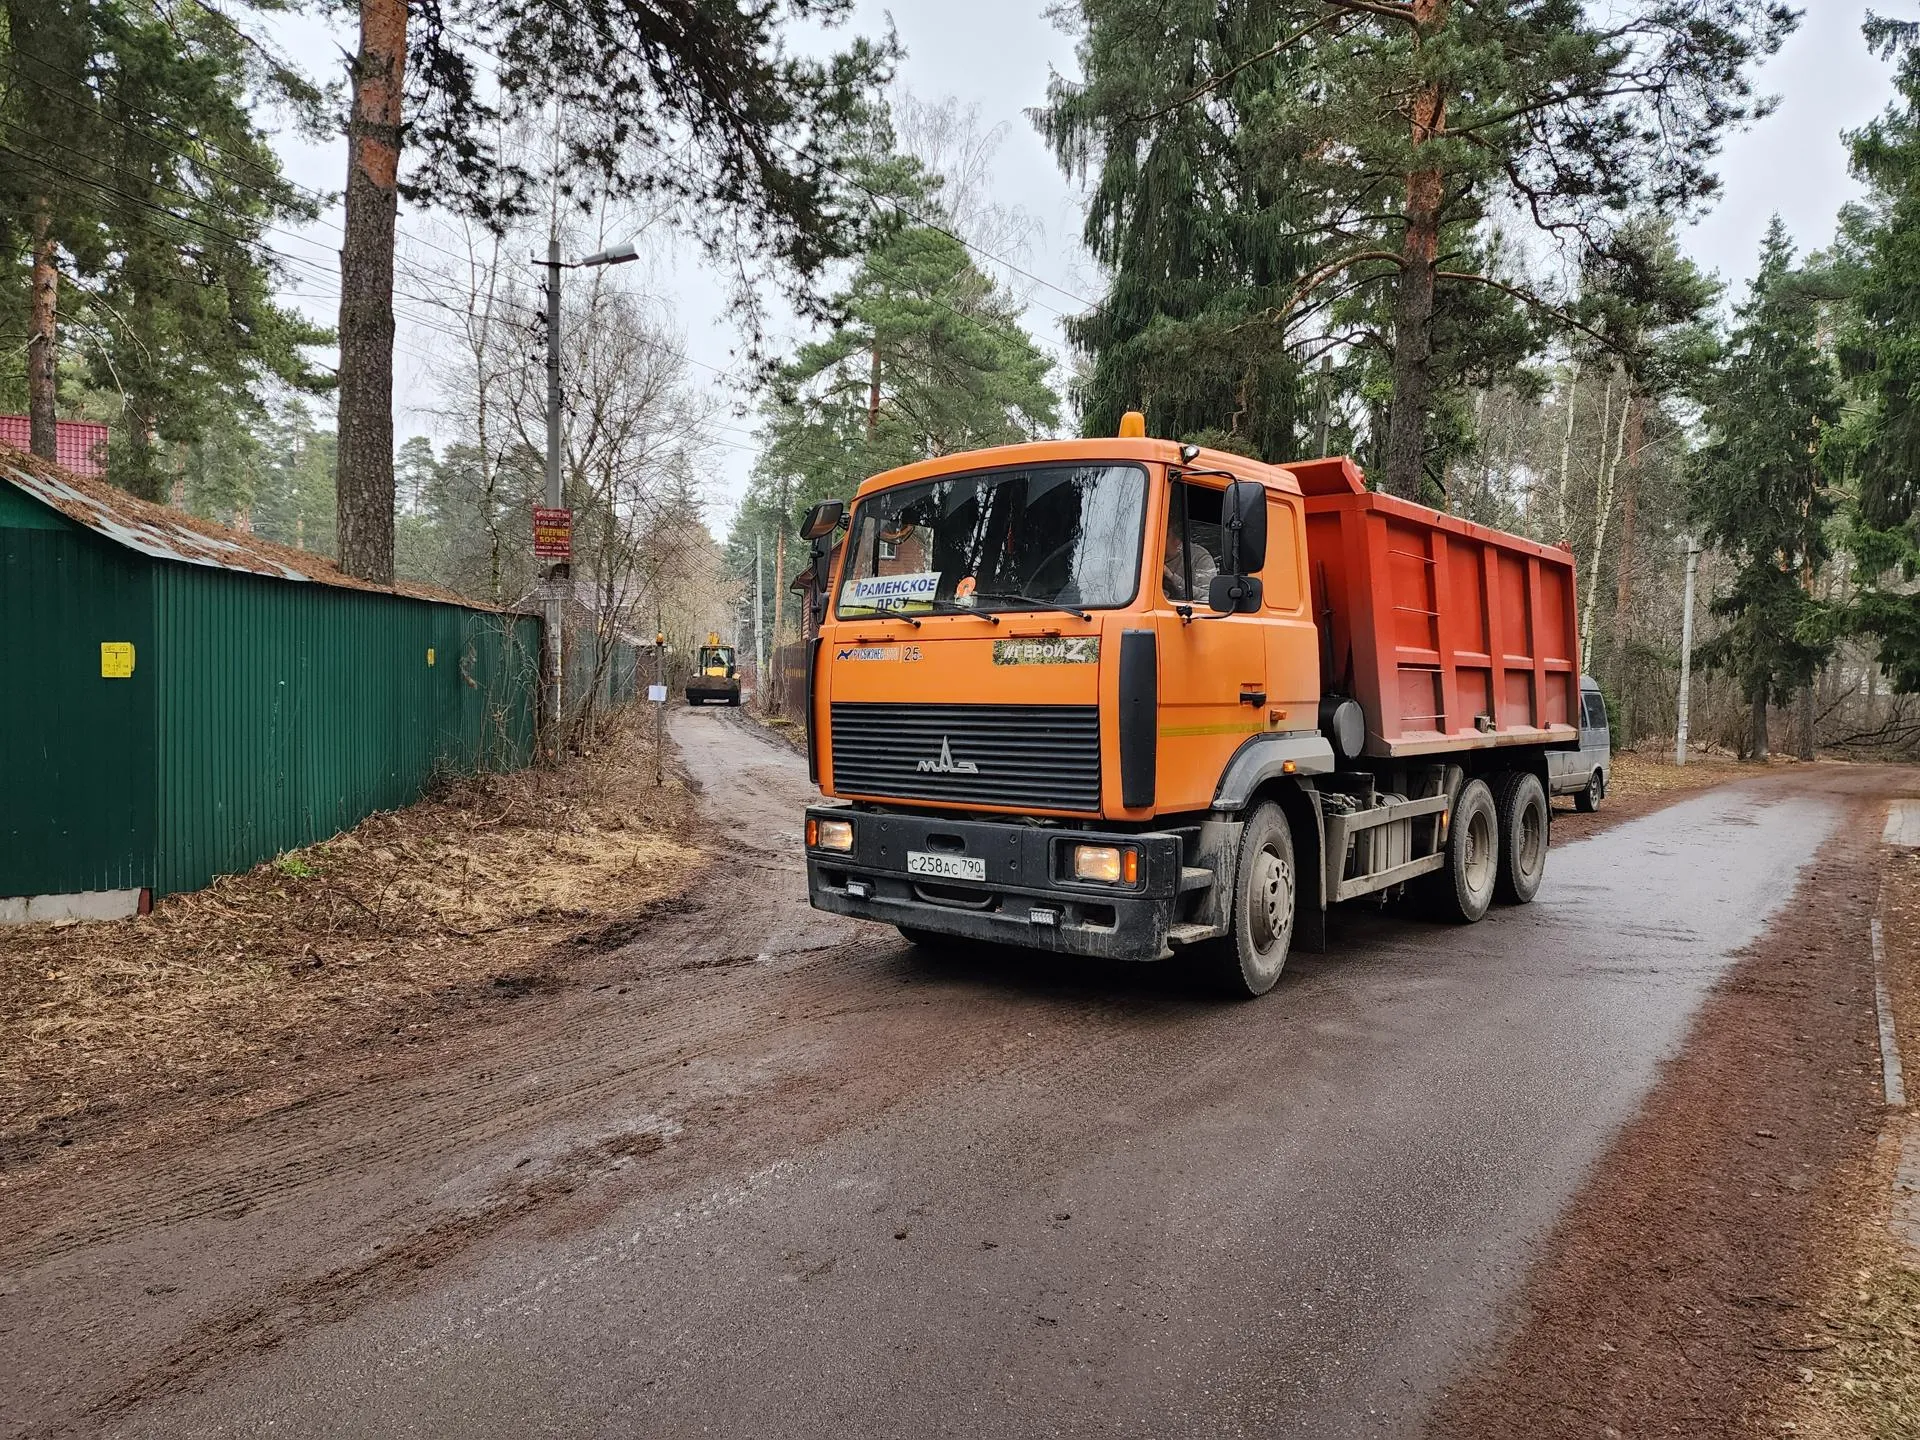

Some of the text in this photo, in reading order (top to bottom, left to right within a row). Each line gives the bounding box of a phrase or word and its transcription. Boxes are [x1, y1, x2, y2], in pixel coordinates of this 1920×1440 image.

[860, 578, 937, 597] РАМЕНСКОЕ
[904, 646, 920, 661] 25
[961, 859, 981, 873] 790
